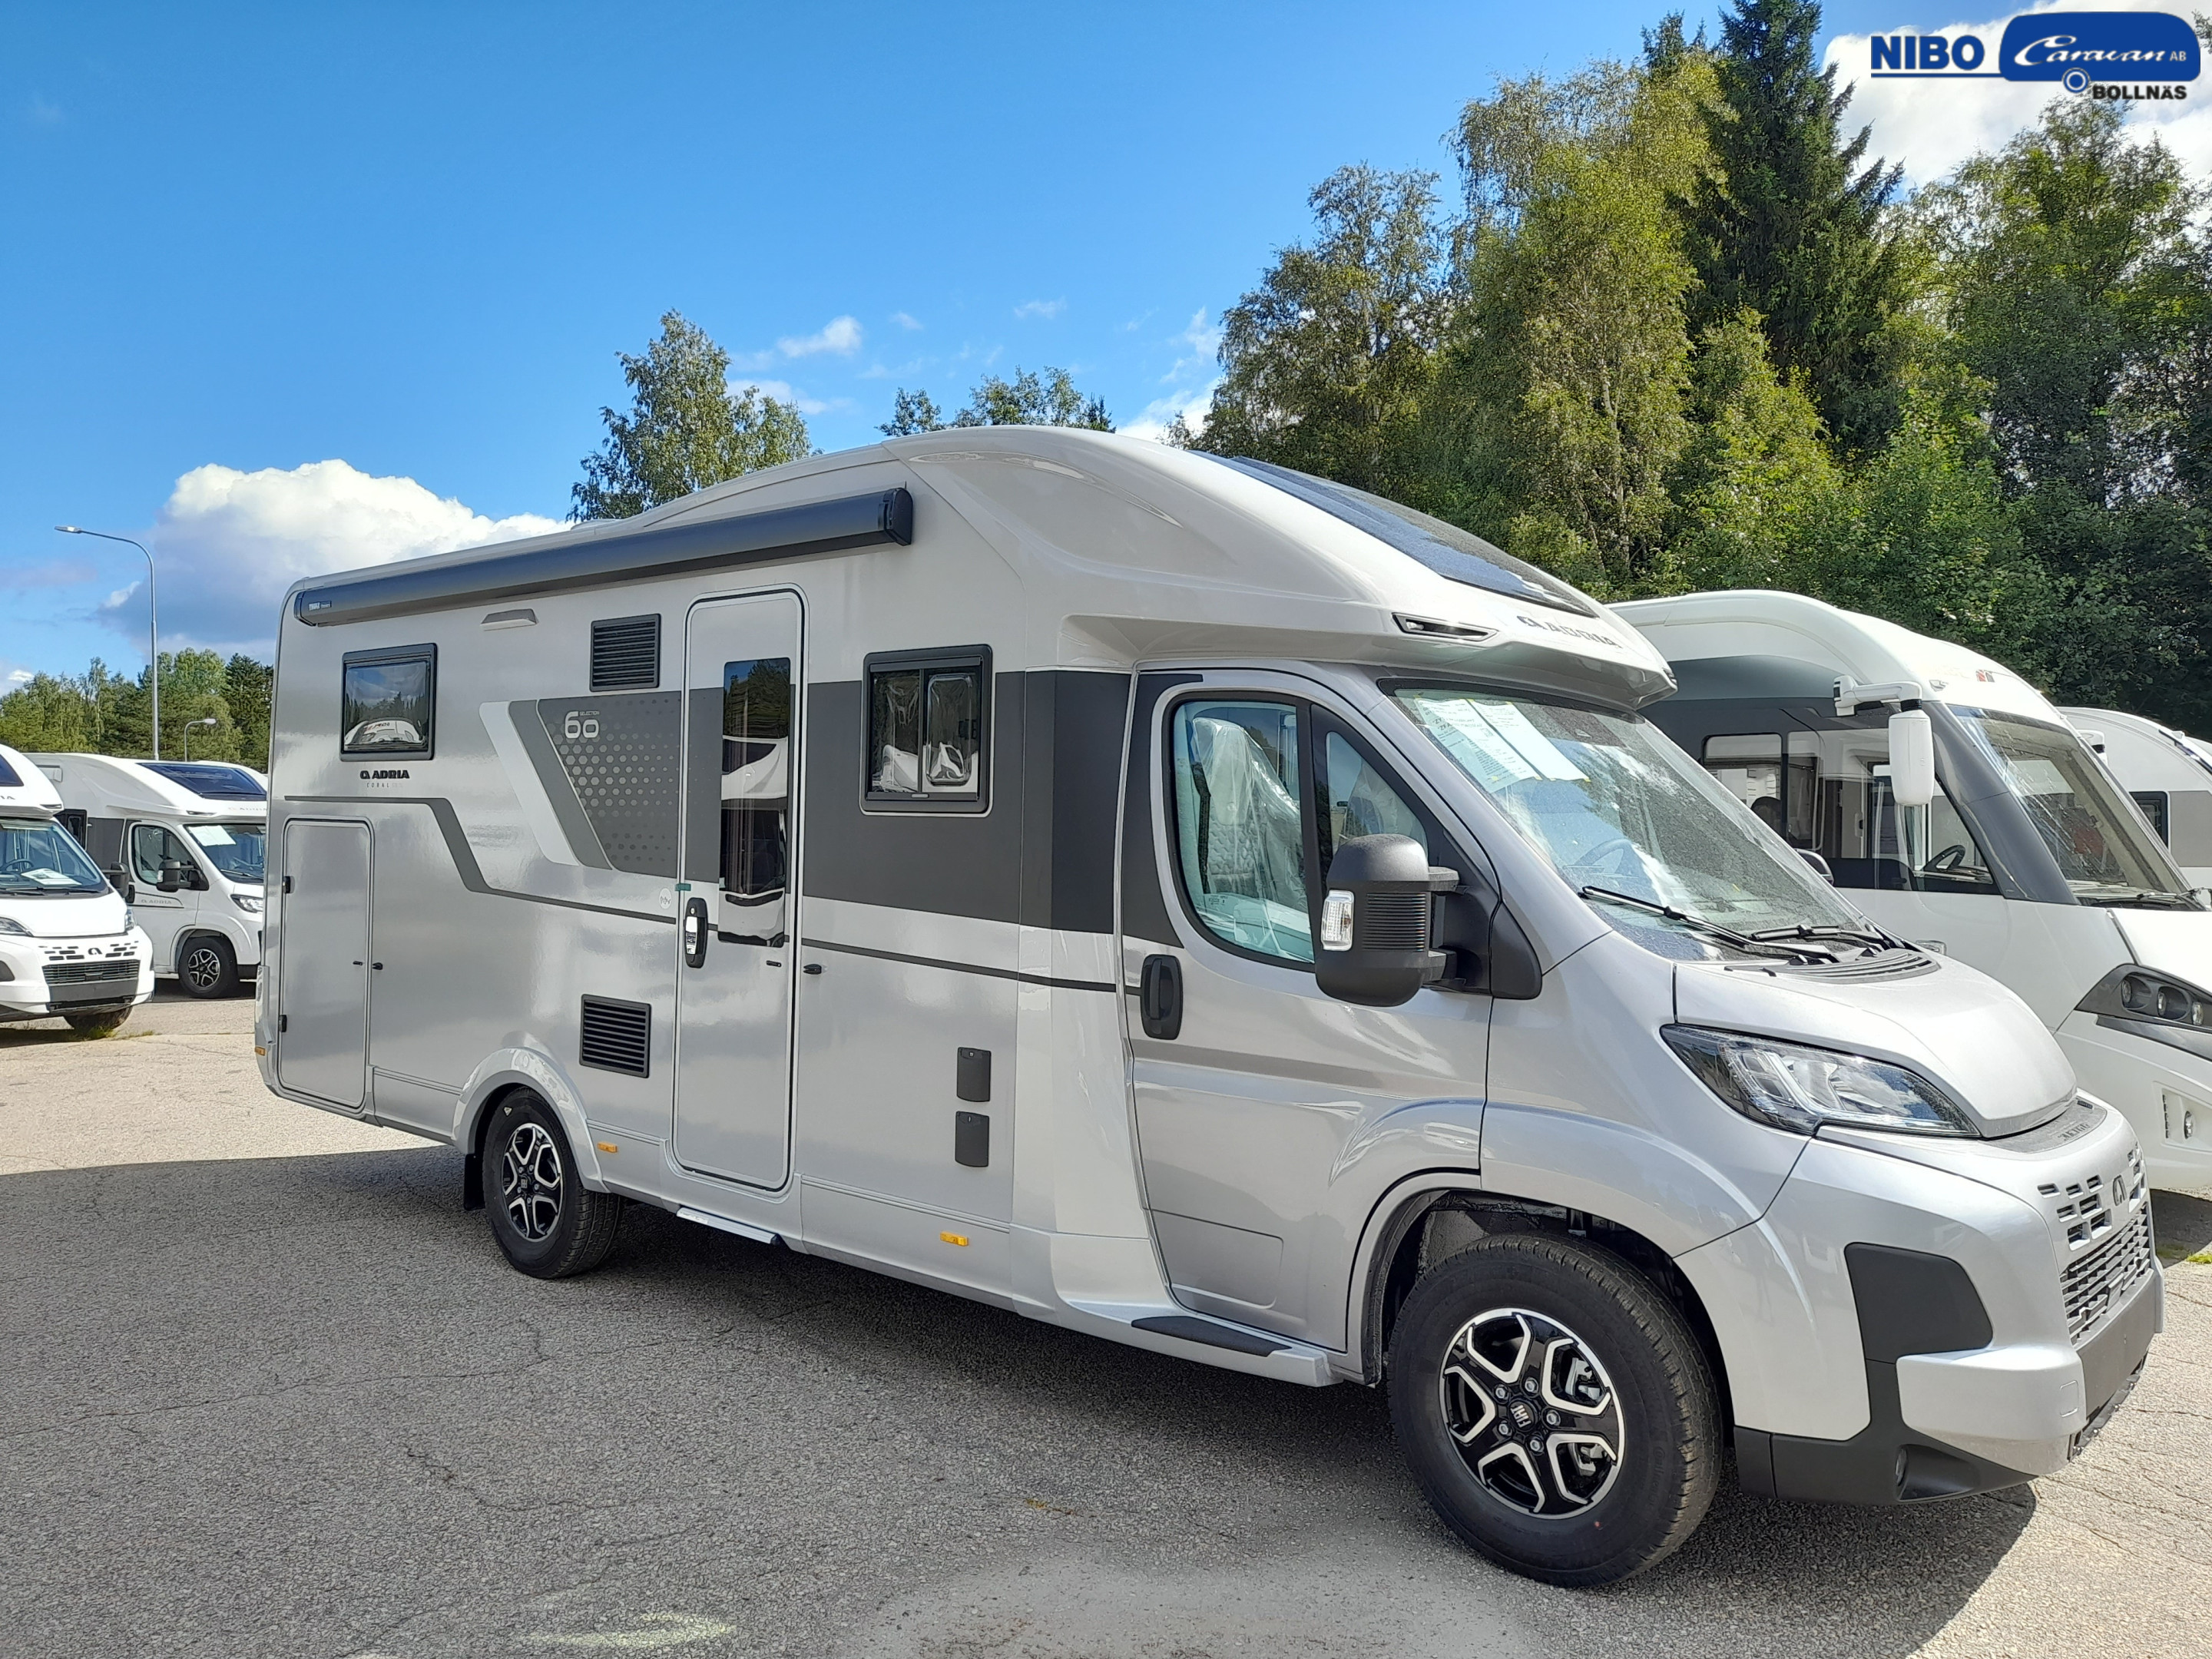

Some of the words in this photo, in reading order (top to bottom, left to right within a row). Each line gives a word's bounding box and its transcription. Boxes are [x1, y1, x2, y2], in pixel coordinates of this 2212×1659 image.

[565, 710, 599, 739] 60
[372, 770, 410, 780] ADRIA
[1510, 1405, 1532, 1428] FIAT
